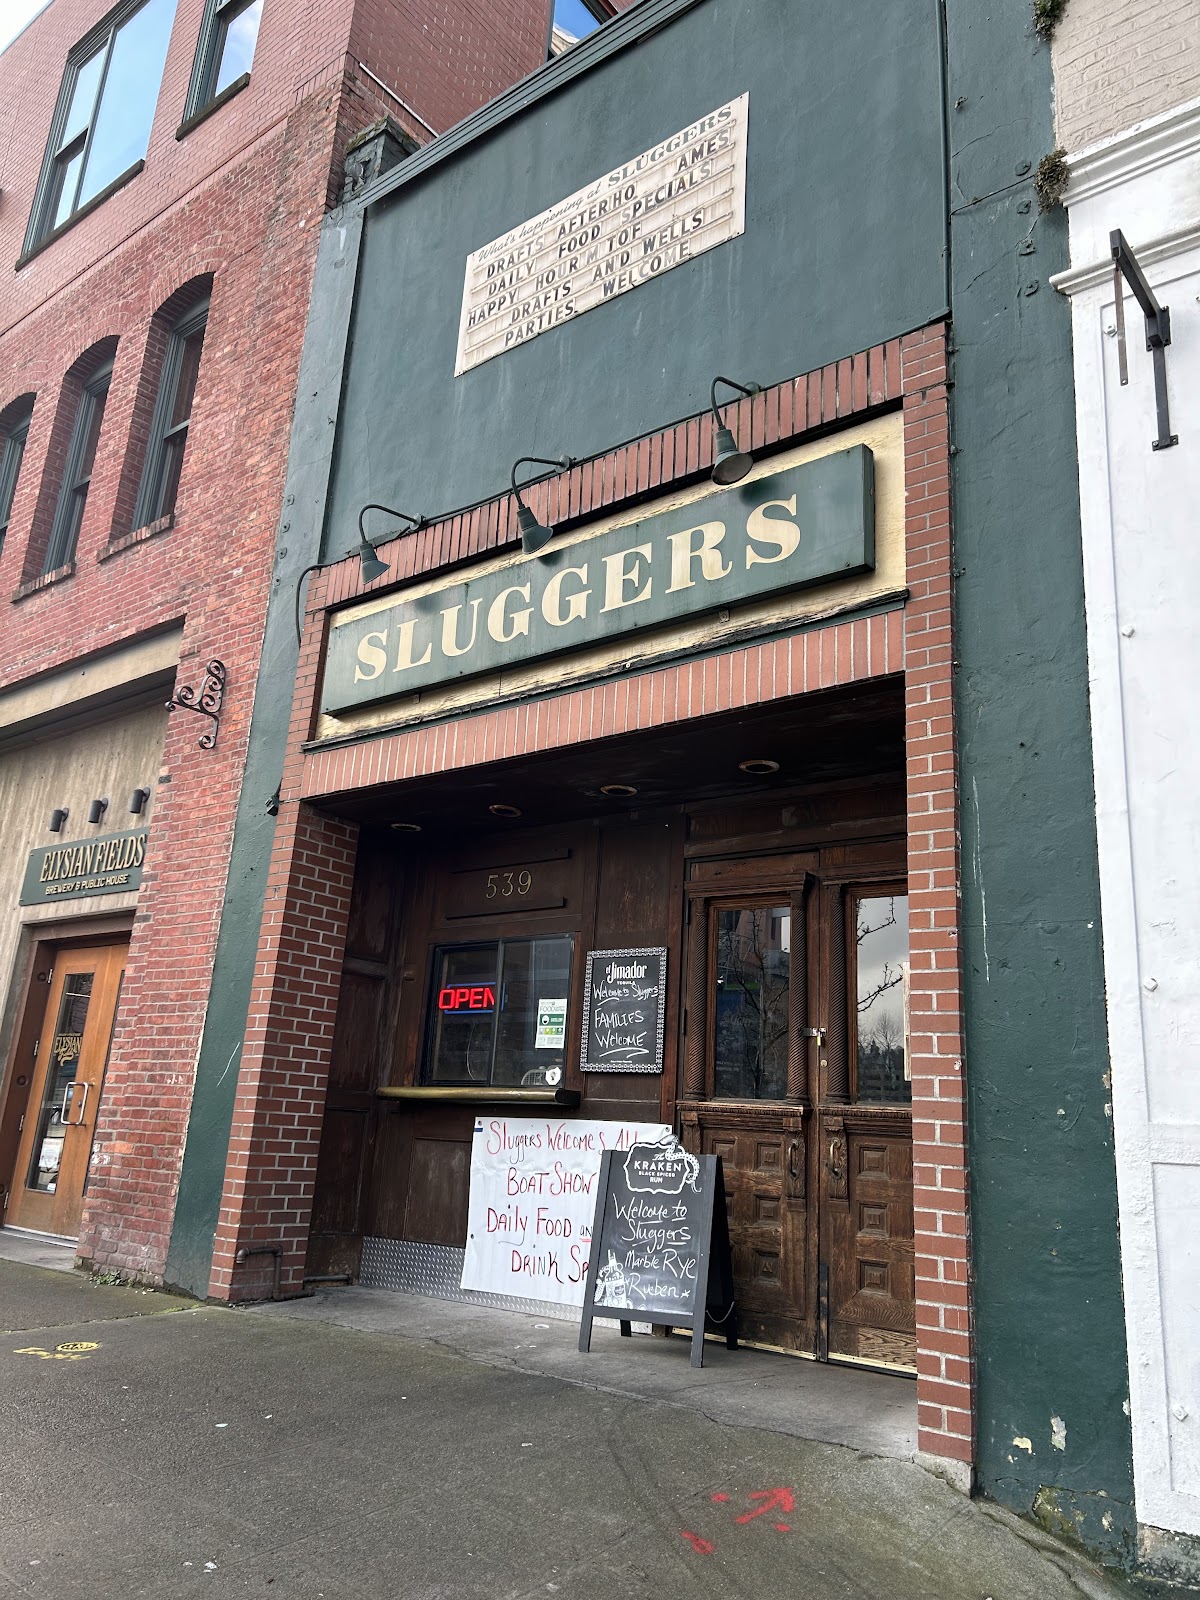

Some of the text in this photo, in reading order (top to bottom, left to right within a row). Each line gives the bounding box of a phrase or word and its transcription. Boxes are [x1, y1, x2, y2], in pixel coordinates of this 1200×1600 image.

[478, 106, 732, 262] What's happening at SLUGGERS
[487, 237, 544, 279] DRAFTS
[677, 130, 729, 173] AMES
[488, 162, 711, 296] DAILY FOOD SPECIALS
[511, 210, 703, 323] DRAFTS AND WELLS
[468, 289, 518, 327] HAPPY
[535, 257, 579, 291] HOUR
[505, 241, 690, 347] PARTIES WELCOME
[354, 494, 801, 683] SLUGGERS
[40, 834, 146, 882] ELYSIAN FIELDS
[45, 883, 76, 895] BREWERY
[81, 878, 105, 890] PUBLIC
[105, 874, 129, 885] HOUSE
[486, 870, 531, 899] 539
[607, 961, 648, 983] Jimador
[439, 988, 495, 1009] OPEN
[595, 1008, 644, 1028] FAMILIES
[507, 1161, 597, 1196] BOAT SHOW
[634, 1161, 681, 1172] KRAKEN
[536, 1208, 572, 1237] FOOD
[613, 1193, 687, 1220] Welcome to
[621, 1219, 692, 1253] Sluggers
[512, 1246, 564, 1284] DRINK
[625, 1248, 696, 1279] Marble Rye
